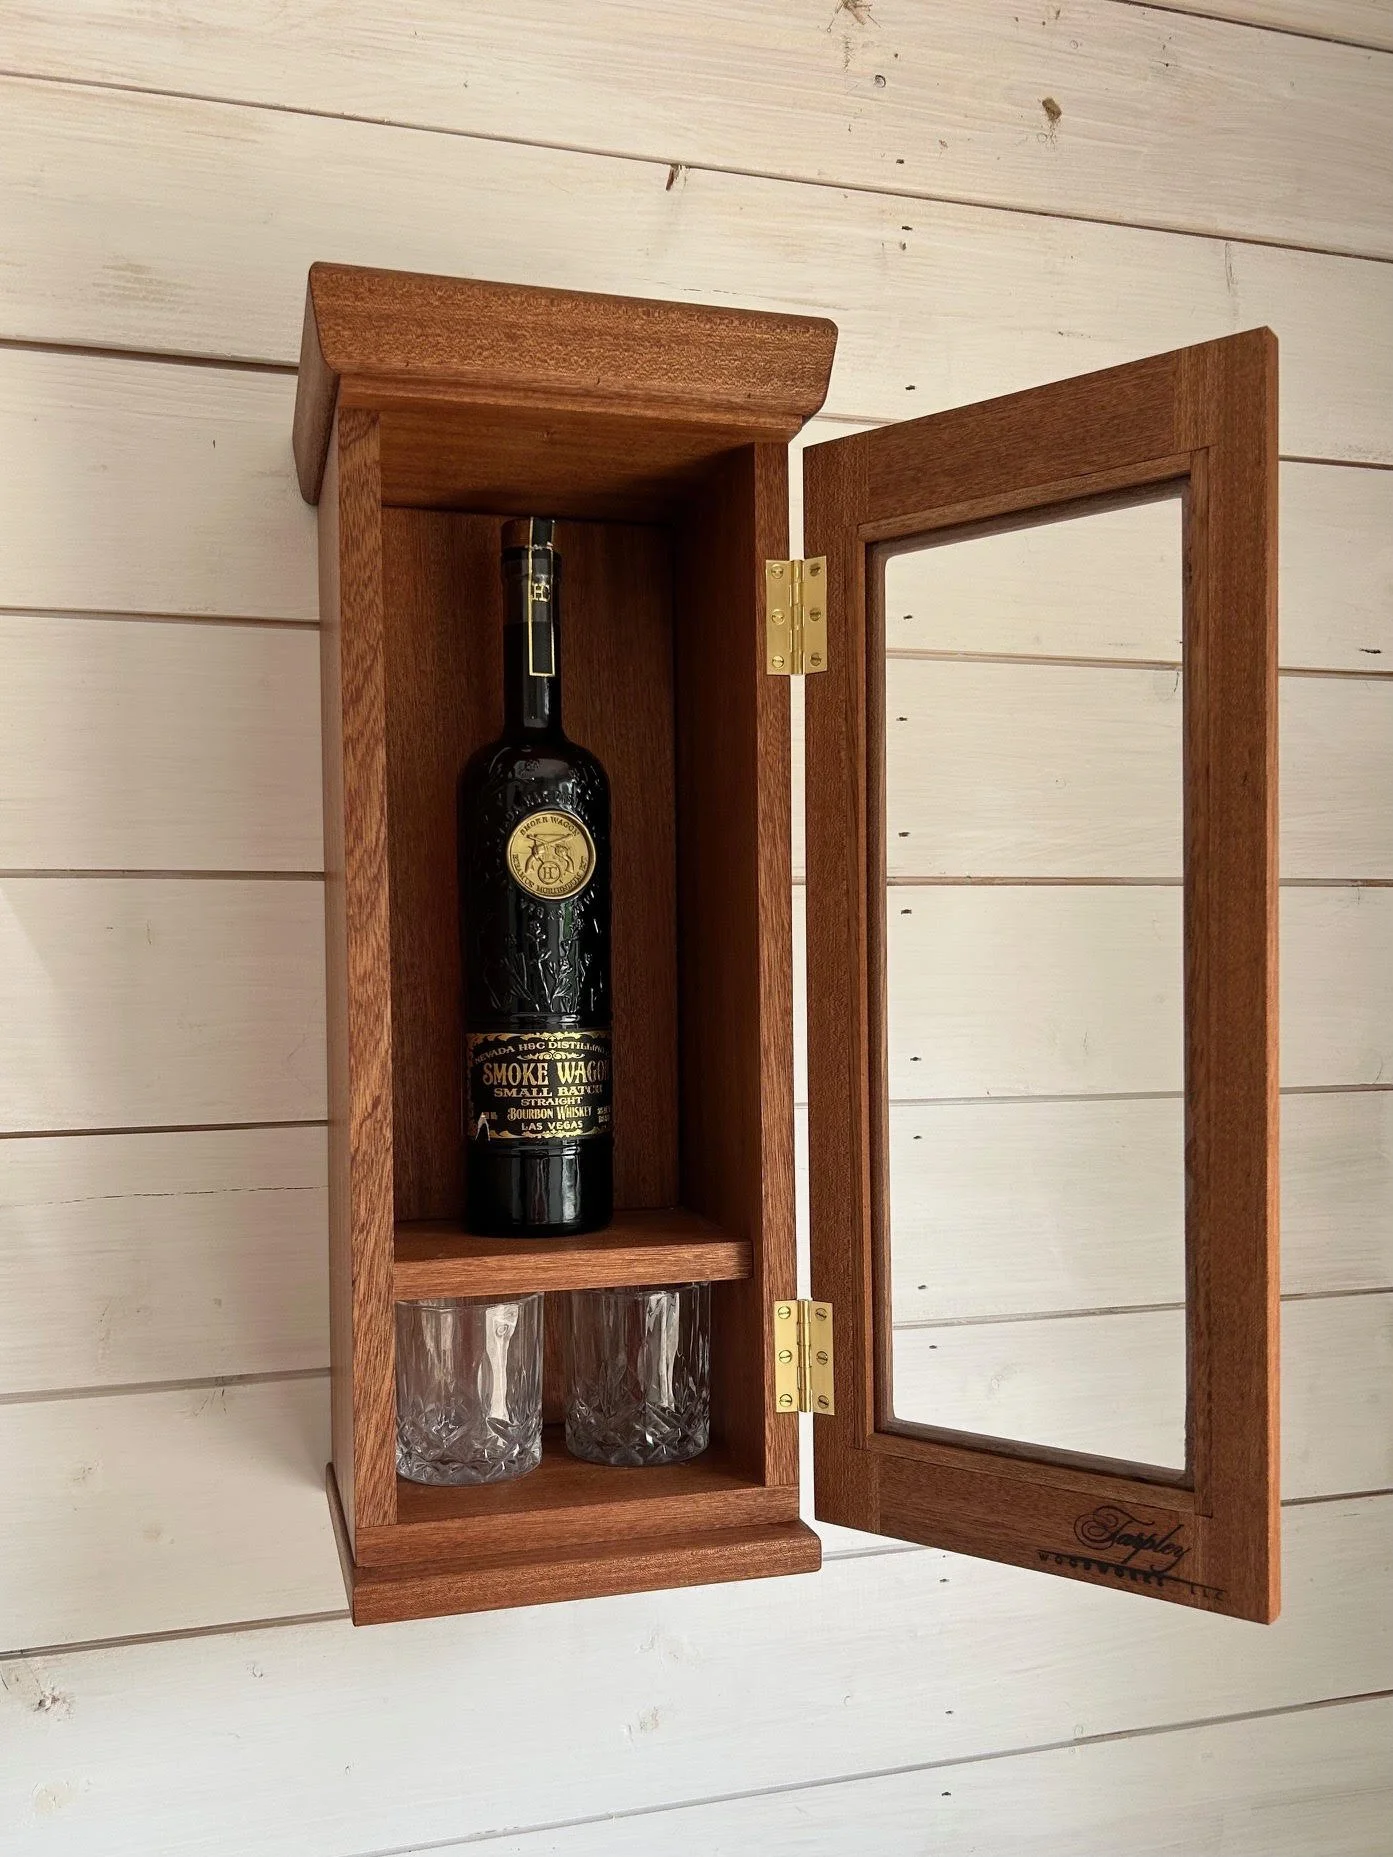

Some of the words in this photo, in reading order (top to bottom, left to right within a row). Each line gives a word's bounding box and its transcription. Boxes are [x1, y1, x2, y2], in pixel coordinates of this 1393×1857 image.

[550, 816, 580, 837] WAGON
[475, 1045, 516, 1064] NEVADA
[482, 1062, 549, 1086] SMOKE
[494, 1087, 552, 1098] SMALL
[557, 1084, 602, 1097] BATCH
[520, 1096, 583, 1106] STRAIGHT
[521, 1122, 543, 1131] LAS
[547, 1120, 583, 1131] VEGAS
